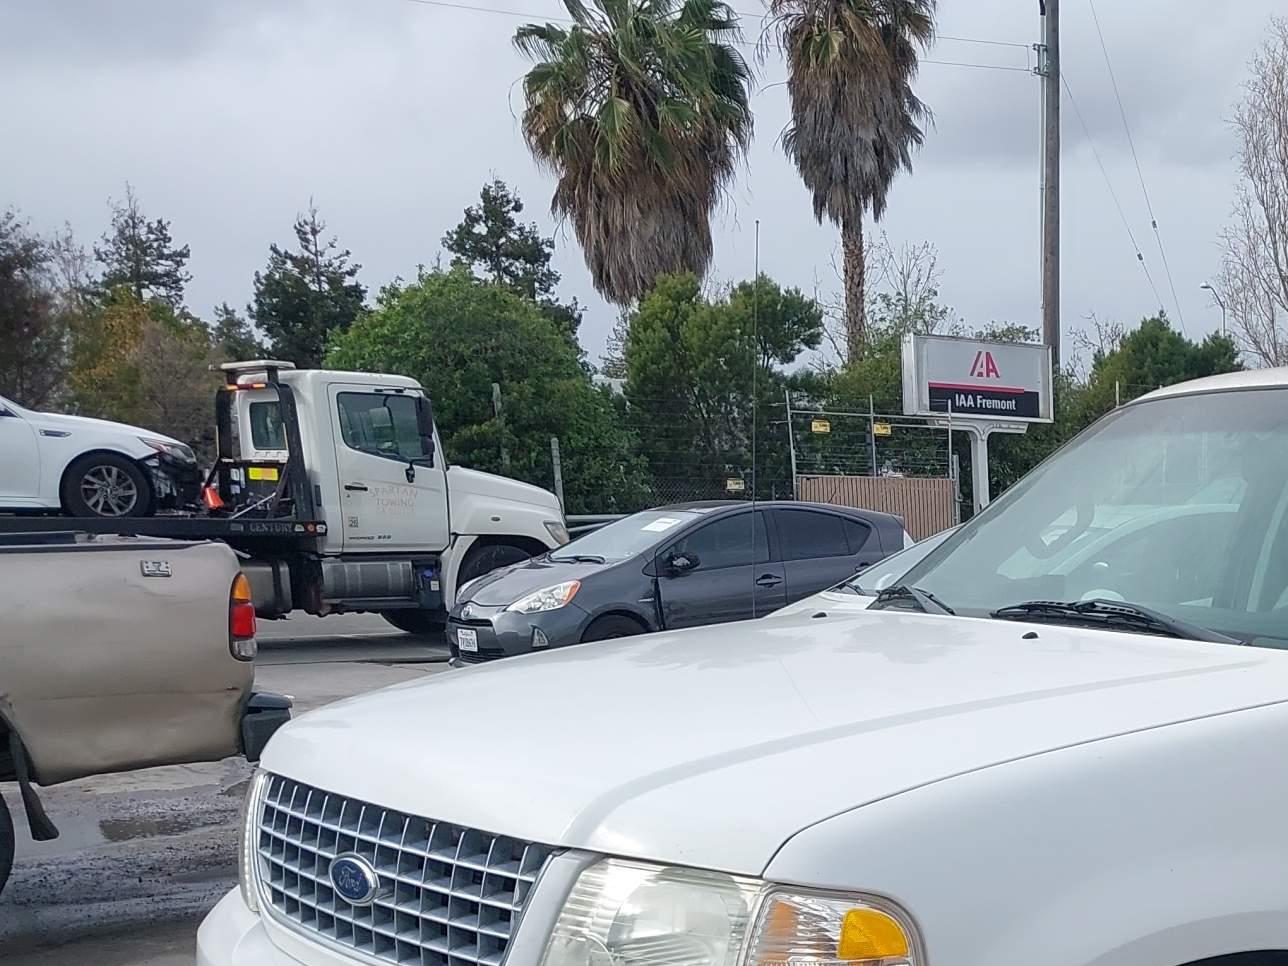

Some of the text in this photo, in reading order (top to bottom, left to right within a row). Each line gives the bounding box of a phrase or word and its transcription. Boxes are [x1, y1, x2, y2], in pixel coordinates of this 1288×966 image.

[955, 393, 1017, 411] IAA Fremont
[249, 522, 293, 533] CENTURY
